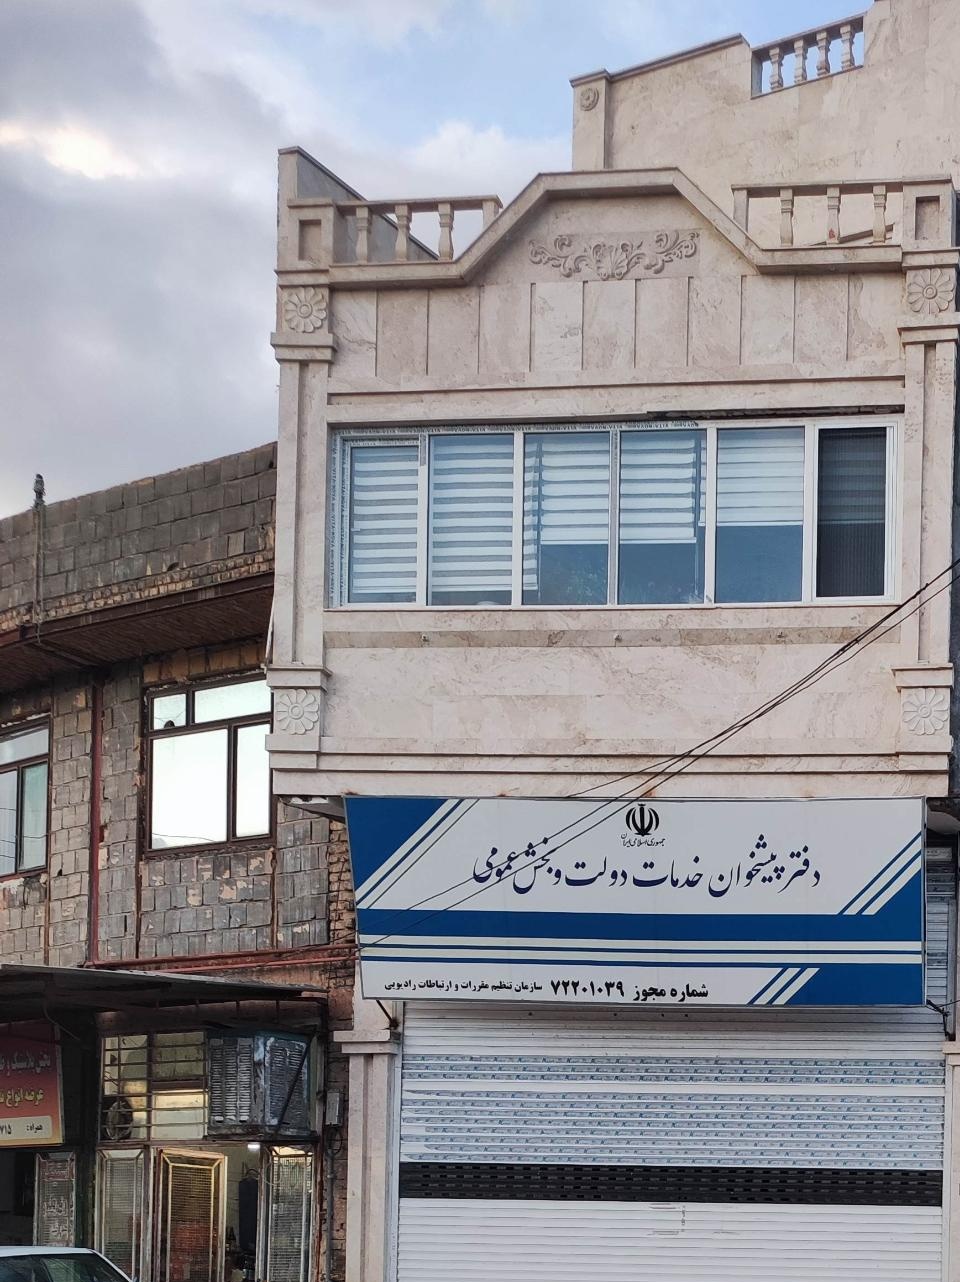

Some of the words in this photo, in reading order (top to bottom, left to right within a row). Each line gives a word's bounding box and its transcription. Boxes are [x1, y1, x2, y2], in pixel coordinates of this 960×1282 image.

[472, 846, 518, 883] عمومی
[512, 837, 557, 894] بخش
[565, 857, 627, 887] دولت
[633, 855, 703, 888] خدمات
[708, 834, 785, 897] پیشخوان
[777, 845, 821, 893] دفتر
[552, 868, 562, 886] و
[384, 979, 417, 991] رادیویی
[418, 979, 452, 992] ارتباطات
[460, 980, 490, 992] مقررات
[491, 981, 513, 991] تنظیم
[514, 981, 543, 993] سازمان
[550, 979, 625, 998] ۷۲۲۰۱۰۳۹
[632, 985, 667, 1002] مجوز
[670, 983, 708, 1002] شماره
